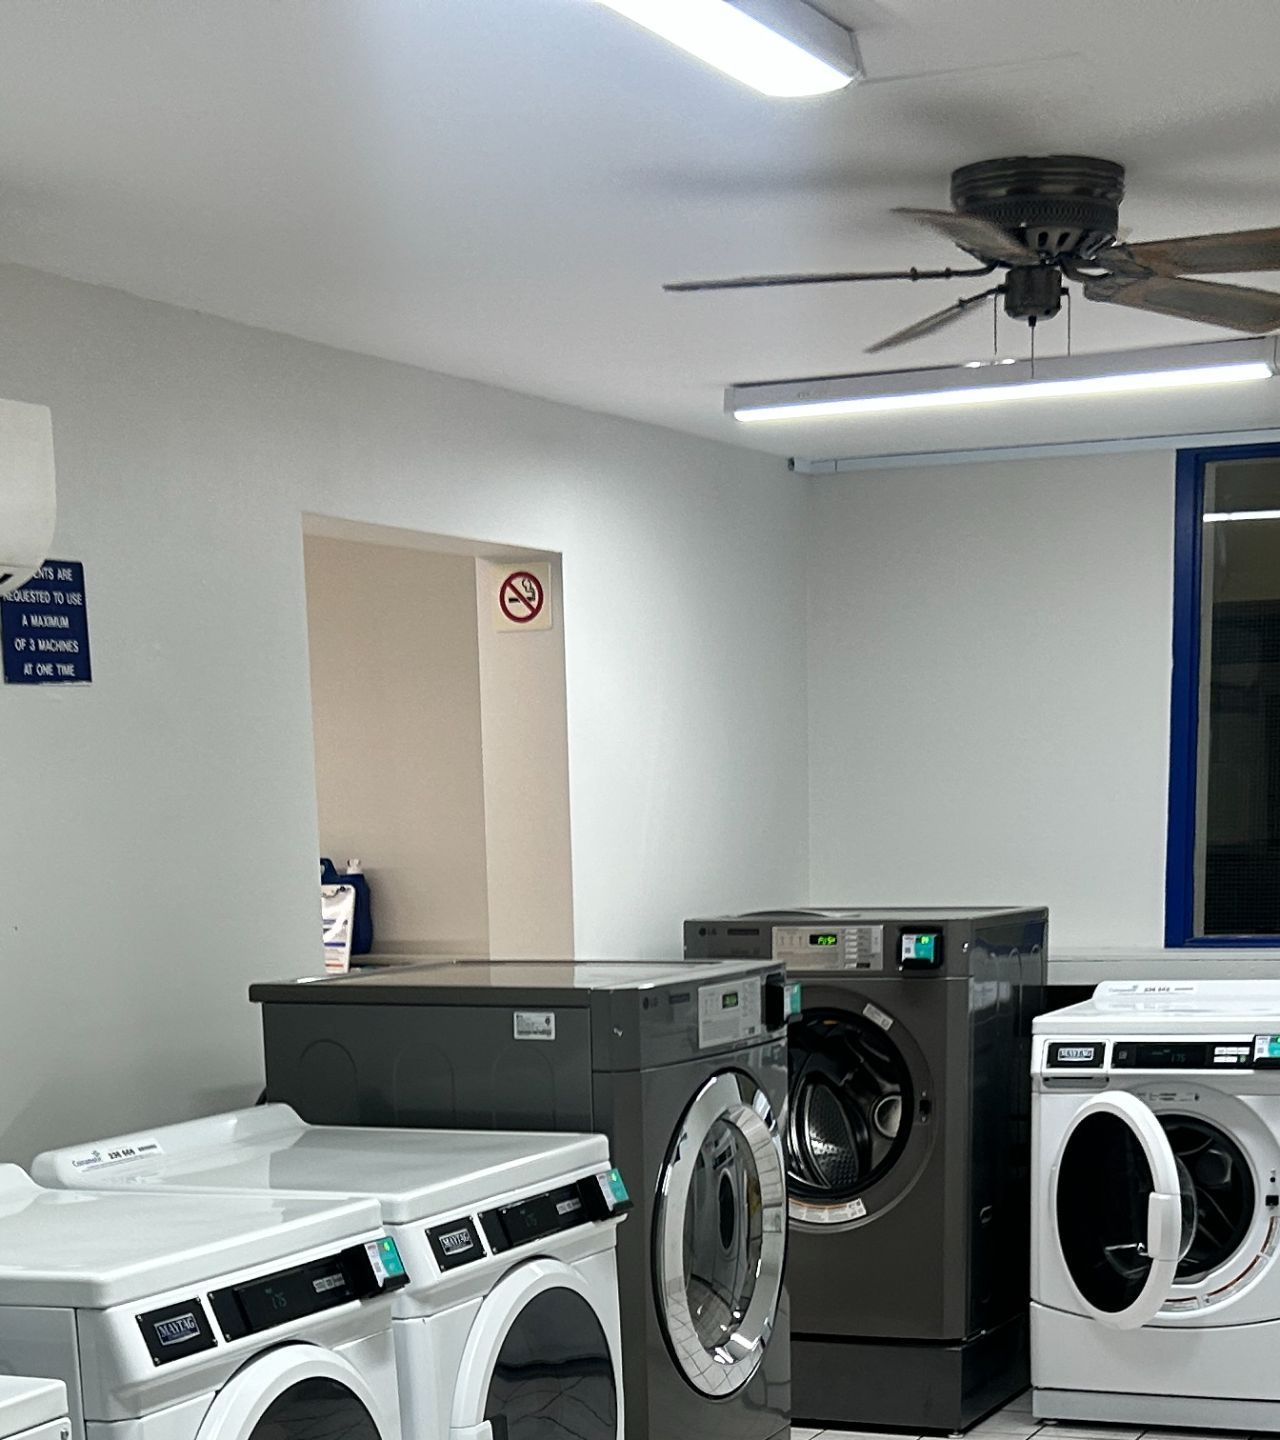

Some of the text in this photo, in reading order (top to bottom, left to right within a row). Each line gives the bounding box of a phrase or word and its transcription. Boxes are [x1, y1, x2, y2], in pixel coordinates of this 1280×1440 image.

[57, 568, 73, 581] ARE
[53, 591, 64, 605] TO
[66, 592, 83, 606] USE
[22, 614, 69, 628] A MAXIMUM
[14, 637, 79, 653] OF 3 MACHINES
[23, 664, 76, 677] AT ONE TIME
